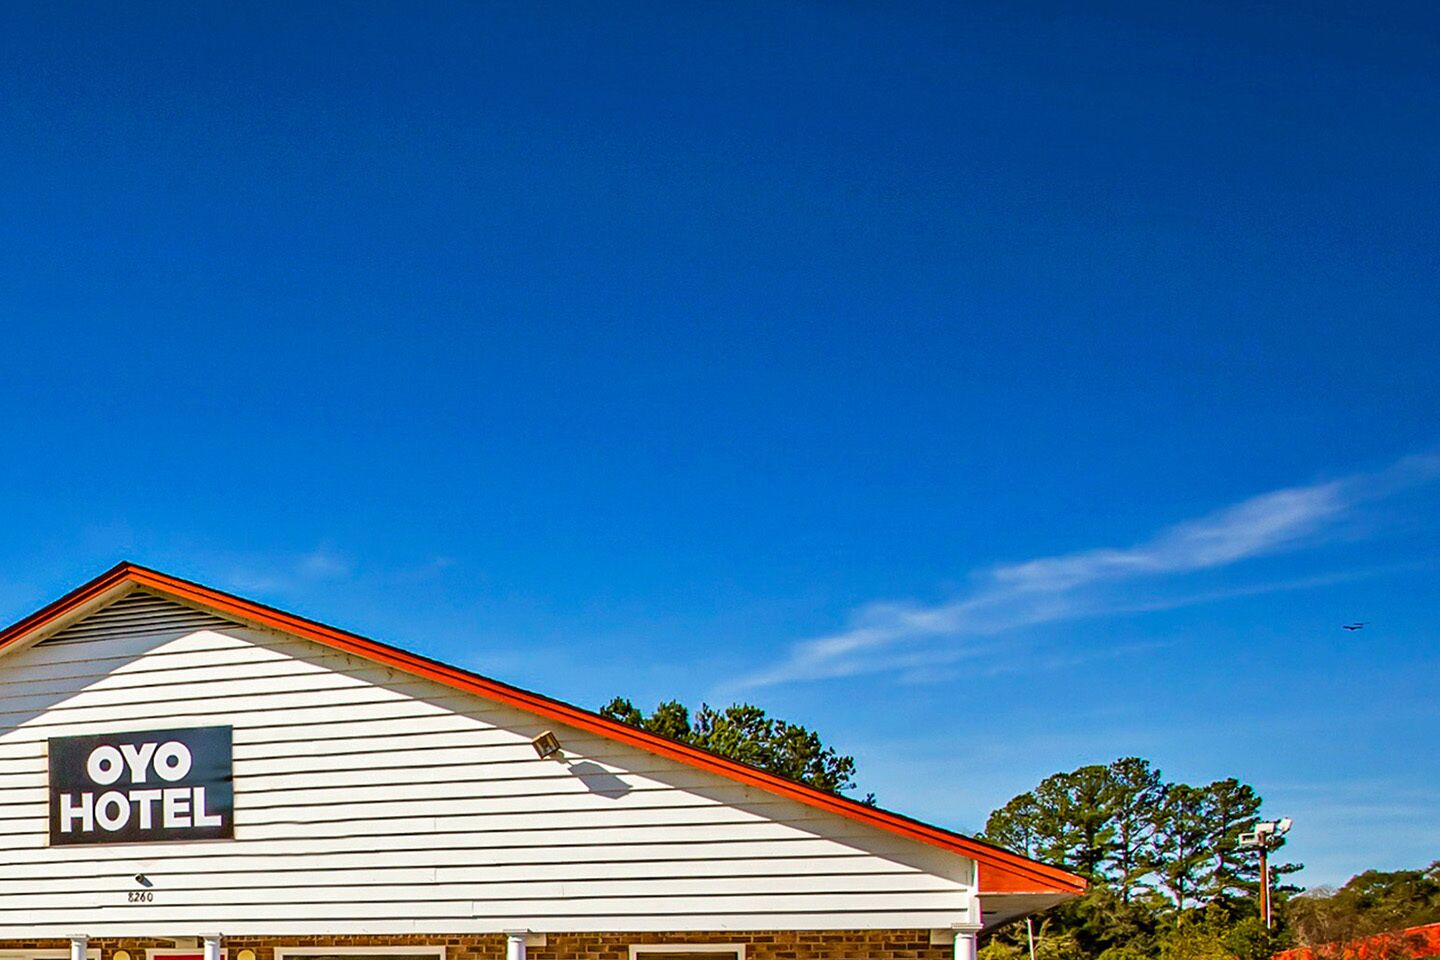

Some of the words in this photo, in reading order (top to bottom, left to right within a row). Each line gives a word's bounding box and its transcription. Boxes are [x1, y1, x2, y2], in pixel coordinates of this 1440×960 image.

[87, 741, 192, 785] OYO
[60, 787, 222, 832] HOTEL
[127, 891, 154, 903] 8260
